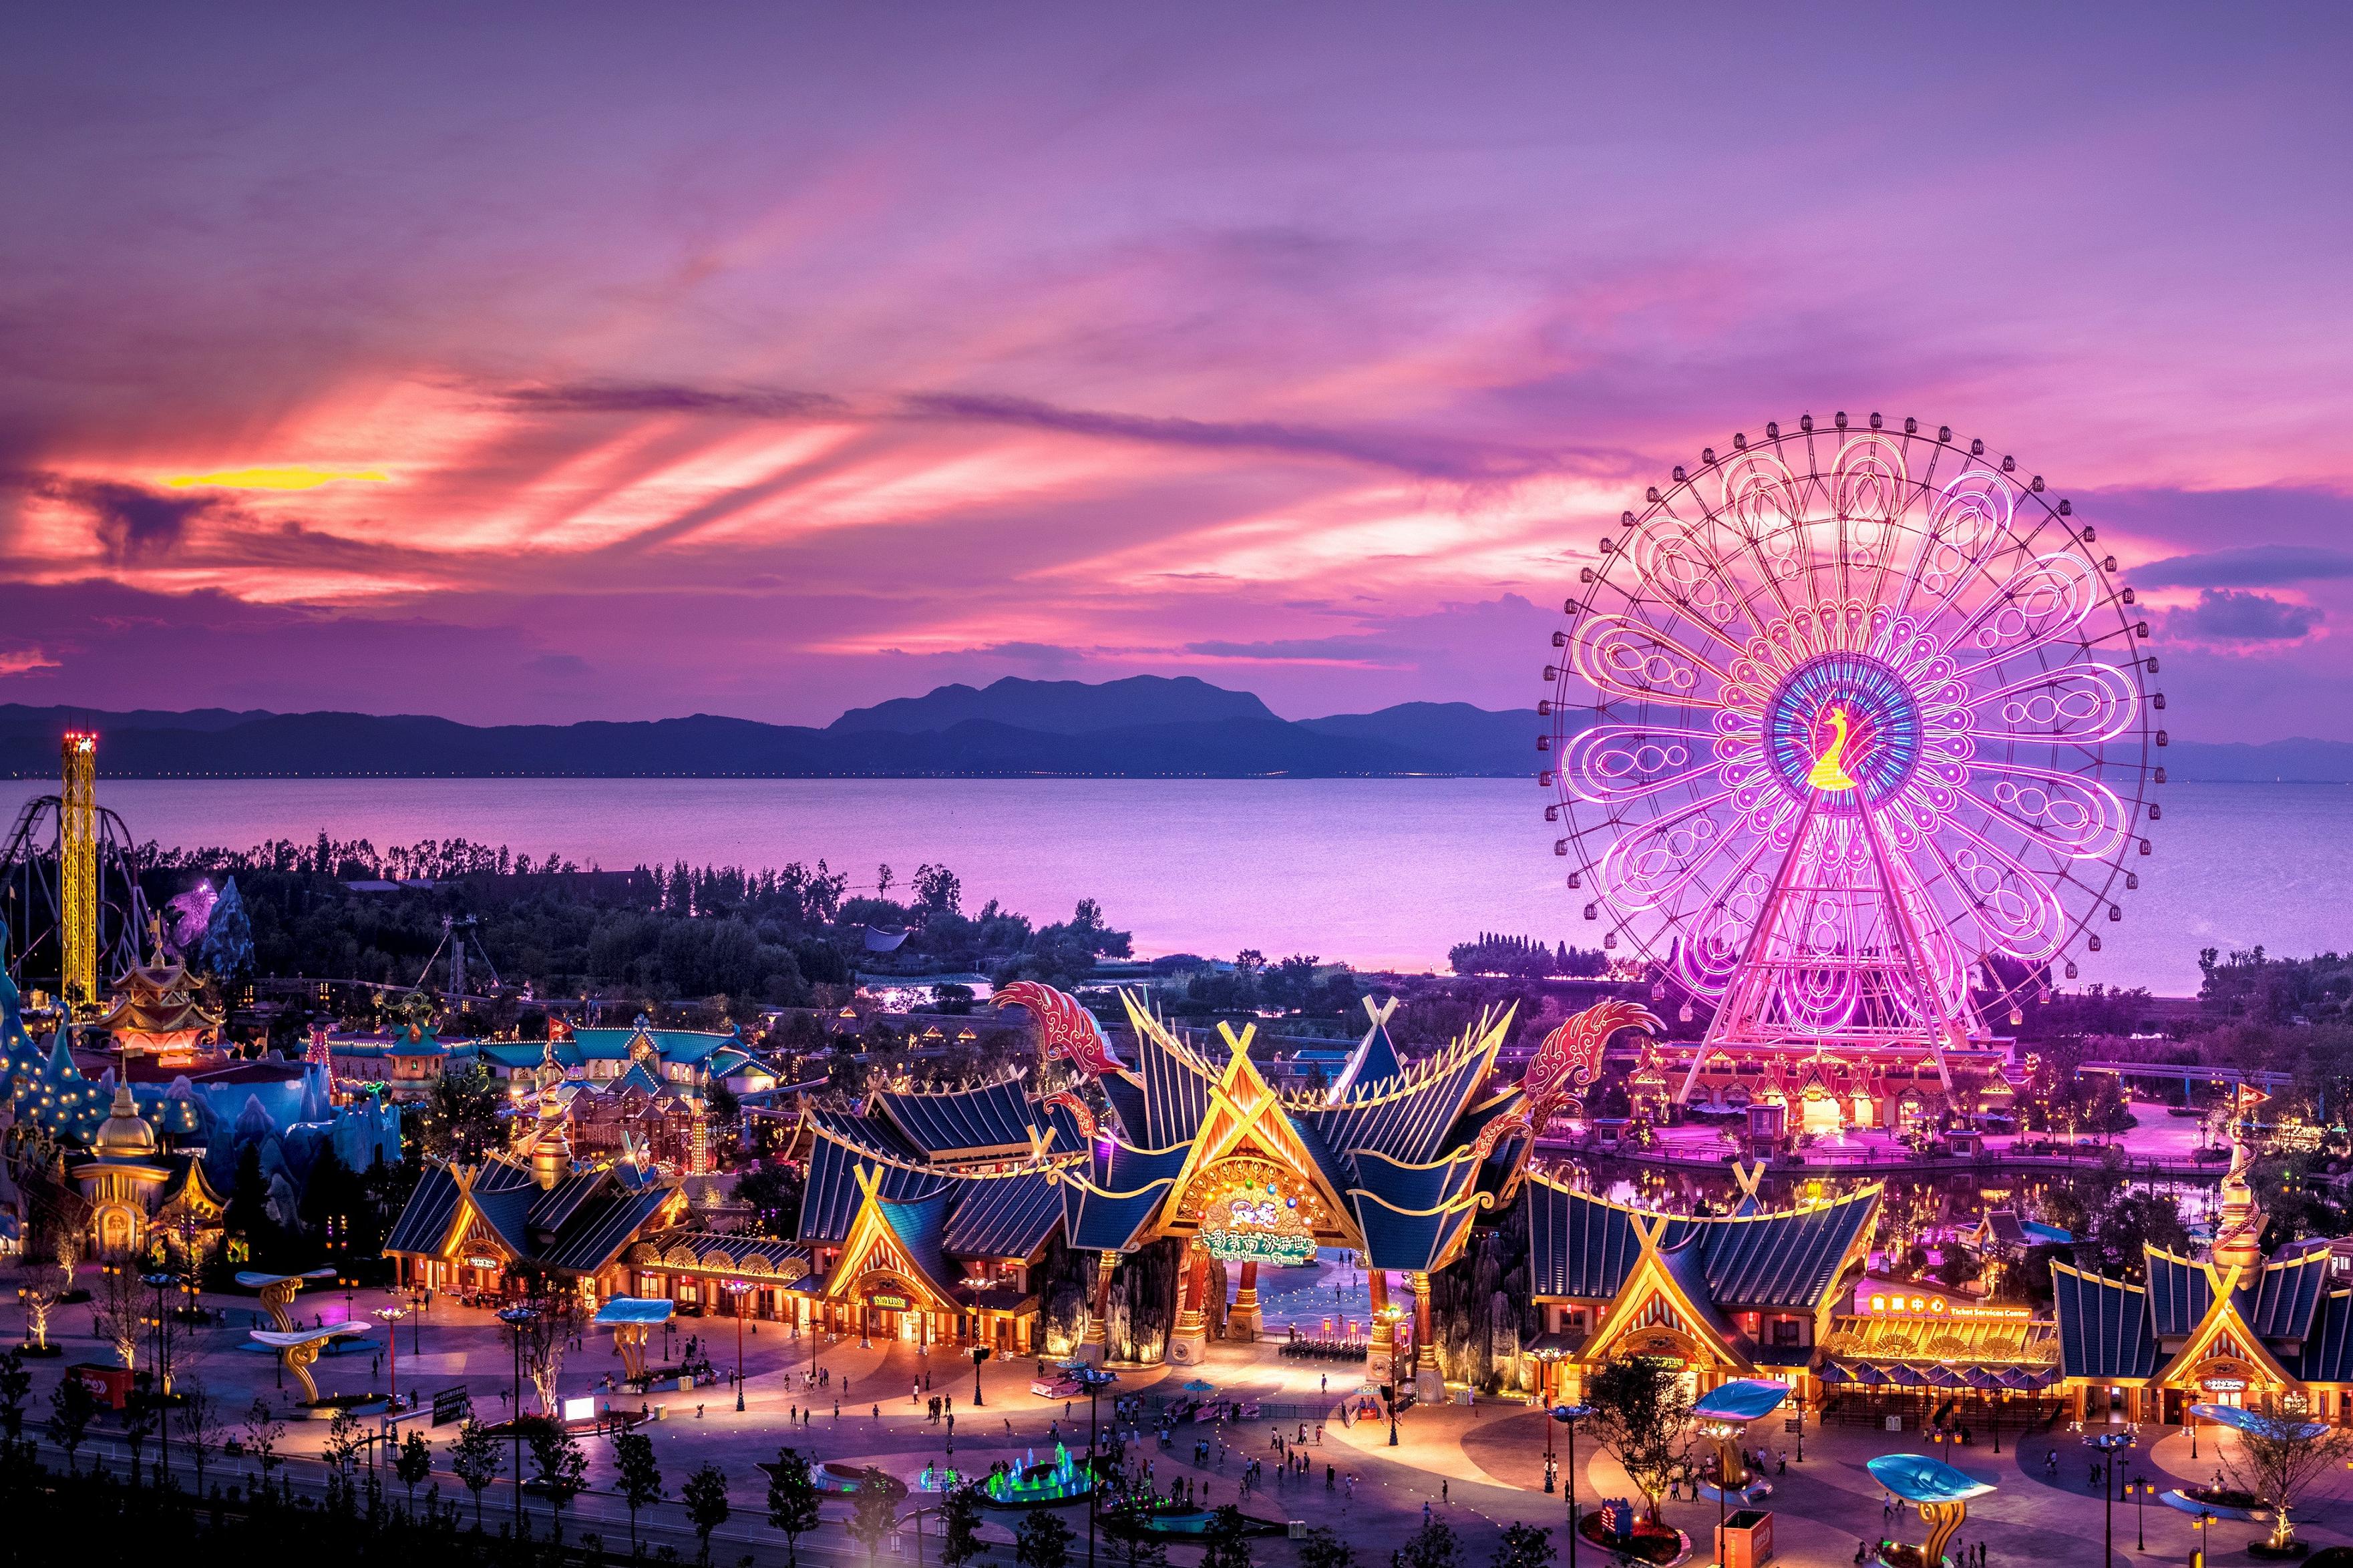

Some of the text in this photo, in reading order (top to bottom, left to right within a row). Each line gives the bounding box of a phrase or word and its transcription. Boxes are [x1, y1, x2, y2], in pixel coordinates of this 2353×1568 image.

[1212, 1249, 1304, 1265] Colorful Yunnan Paradise
[1950, 1308, 1973, 1316] Ticket
[1974, 1308, 2004, 1317] Services
